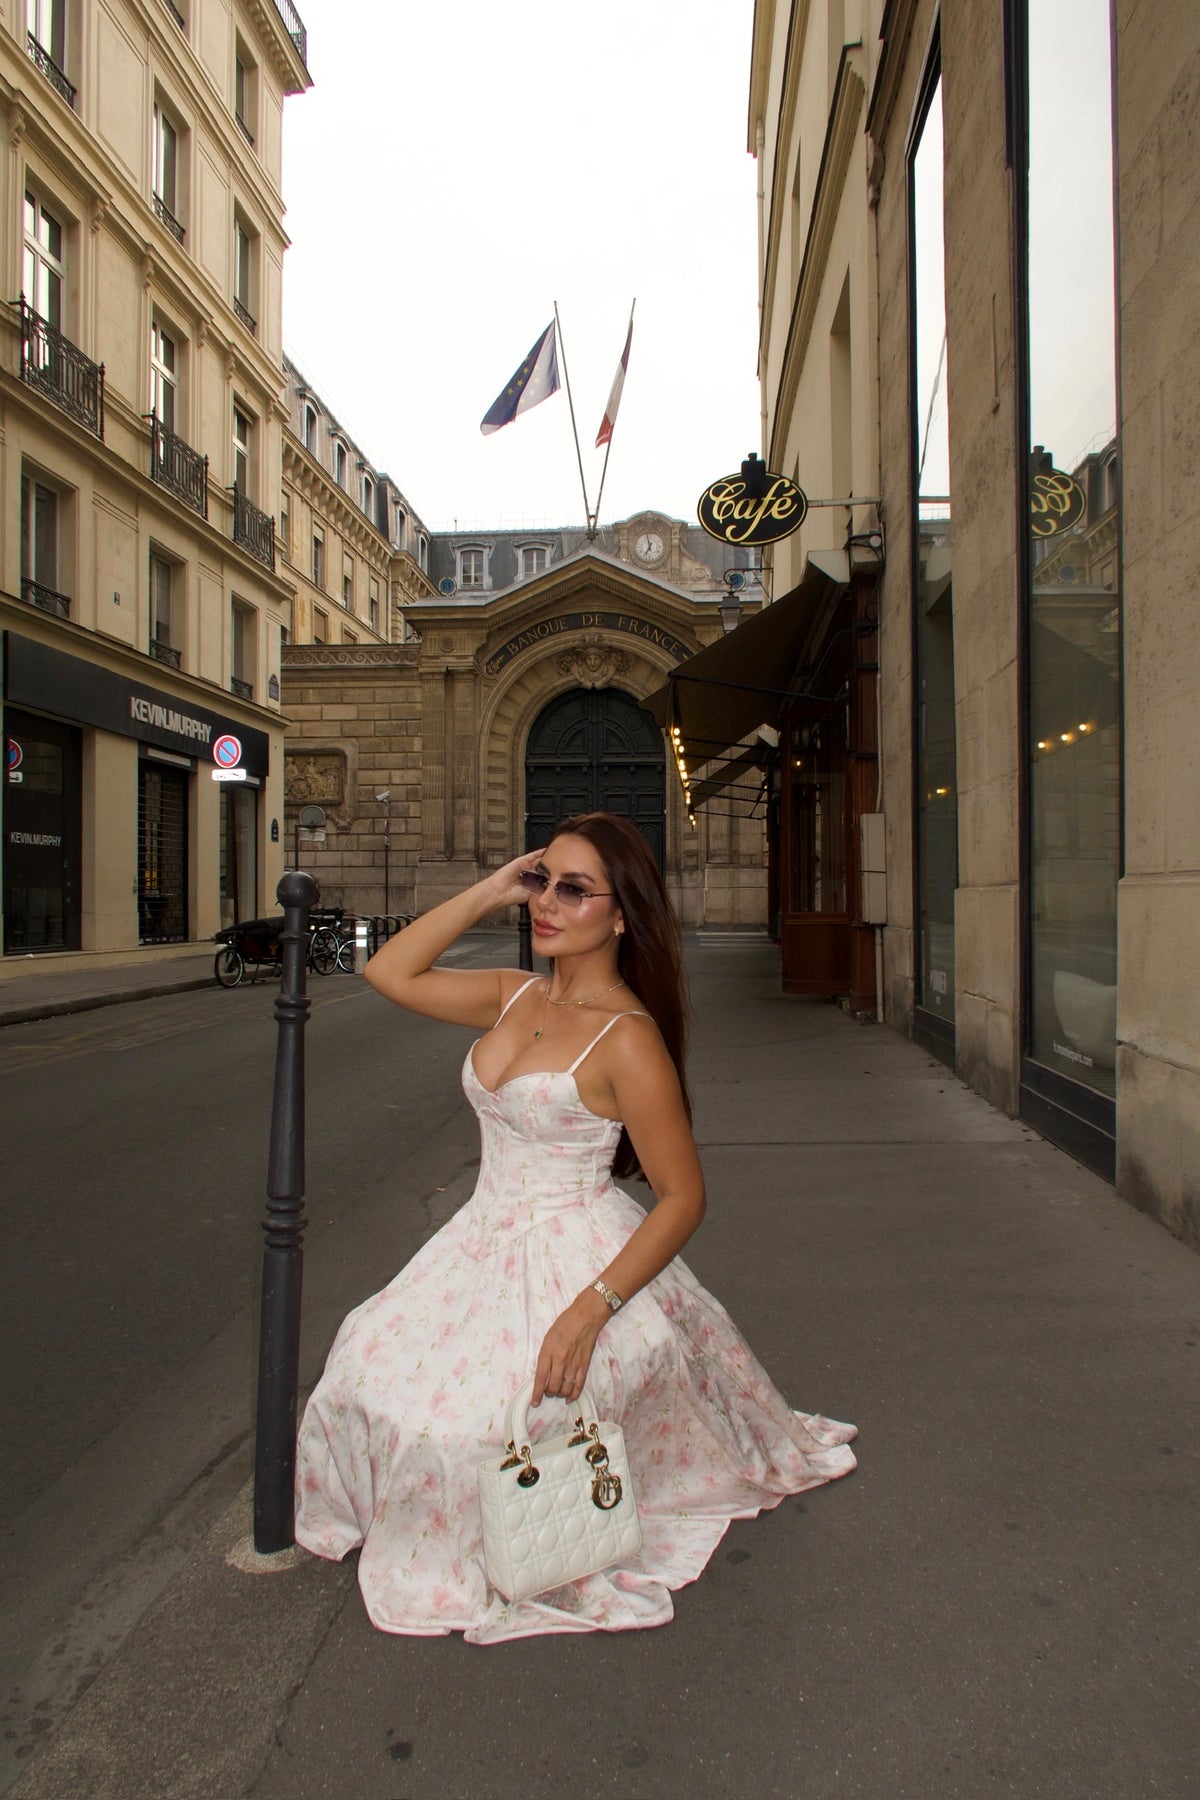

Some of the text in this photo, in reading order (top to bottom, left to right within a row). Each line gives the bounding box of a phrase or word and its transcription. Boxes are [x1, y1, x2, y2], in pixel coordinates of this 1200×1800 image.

[709, 478, 798, 542] Café
[506, 613, 680, 655] BANQUE DE FRANCE
[130, 696, 212, 744] KEVIN.MURPHY
